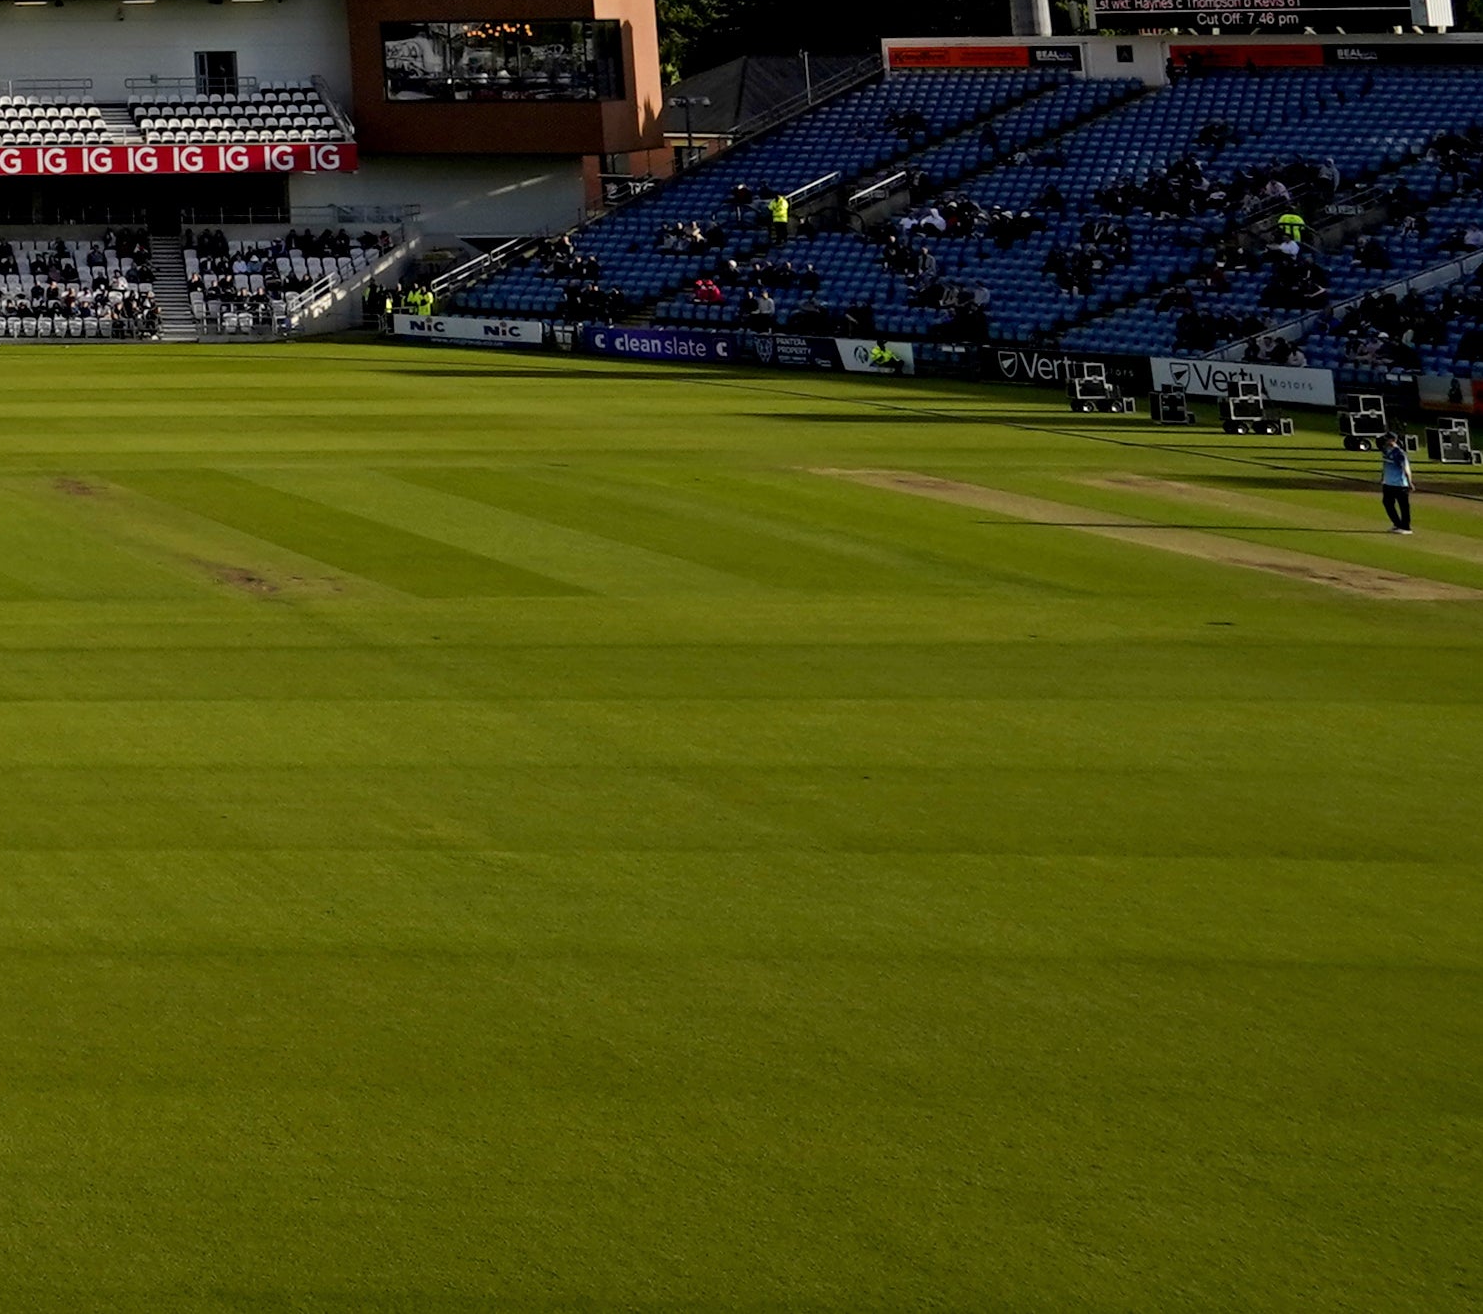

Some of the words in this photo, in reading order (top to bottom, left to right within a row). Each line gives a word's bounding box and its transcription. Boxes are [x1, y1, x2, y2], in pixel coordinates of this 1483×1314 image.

[1176, 0, 1183, 8] c
[1197, 13, 1219, 25] Cut
[1247, 12, 1274, 24] 7.46
[1279, 14, 1299, 26] pm
[83, 148, 113, 173] IG
[173, 147, 204, 173] IG
[264, 145, 294, 171] IG
[309, 144, 340, 171] IG
[777, 346, 811, 355] PROPERTY
[1269, 379, 1314, 392] Motors
